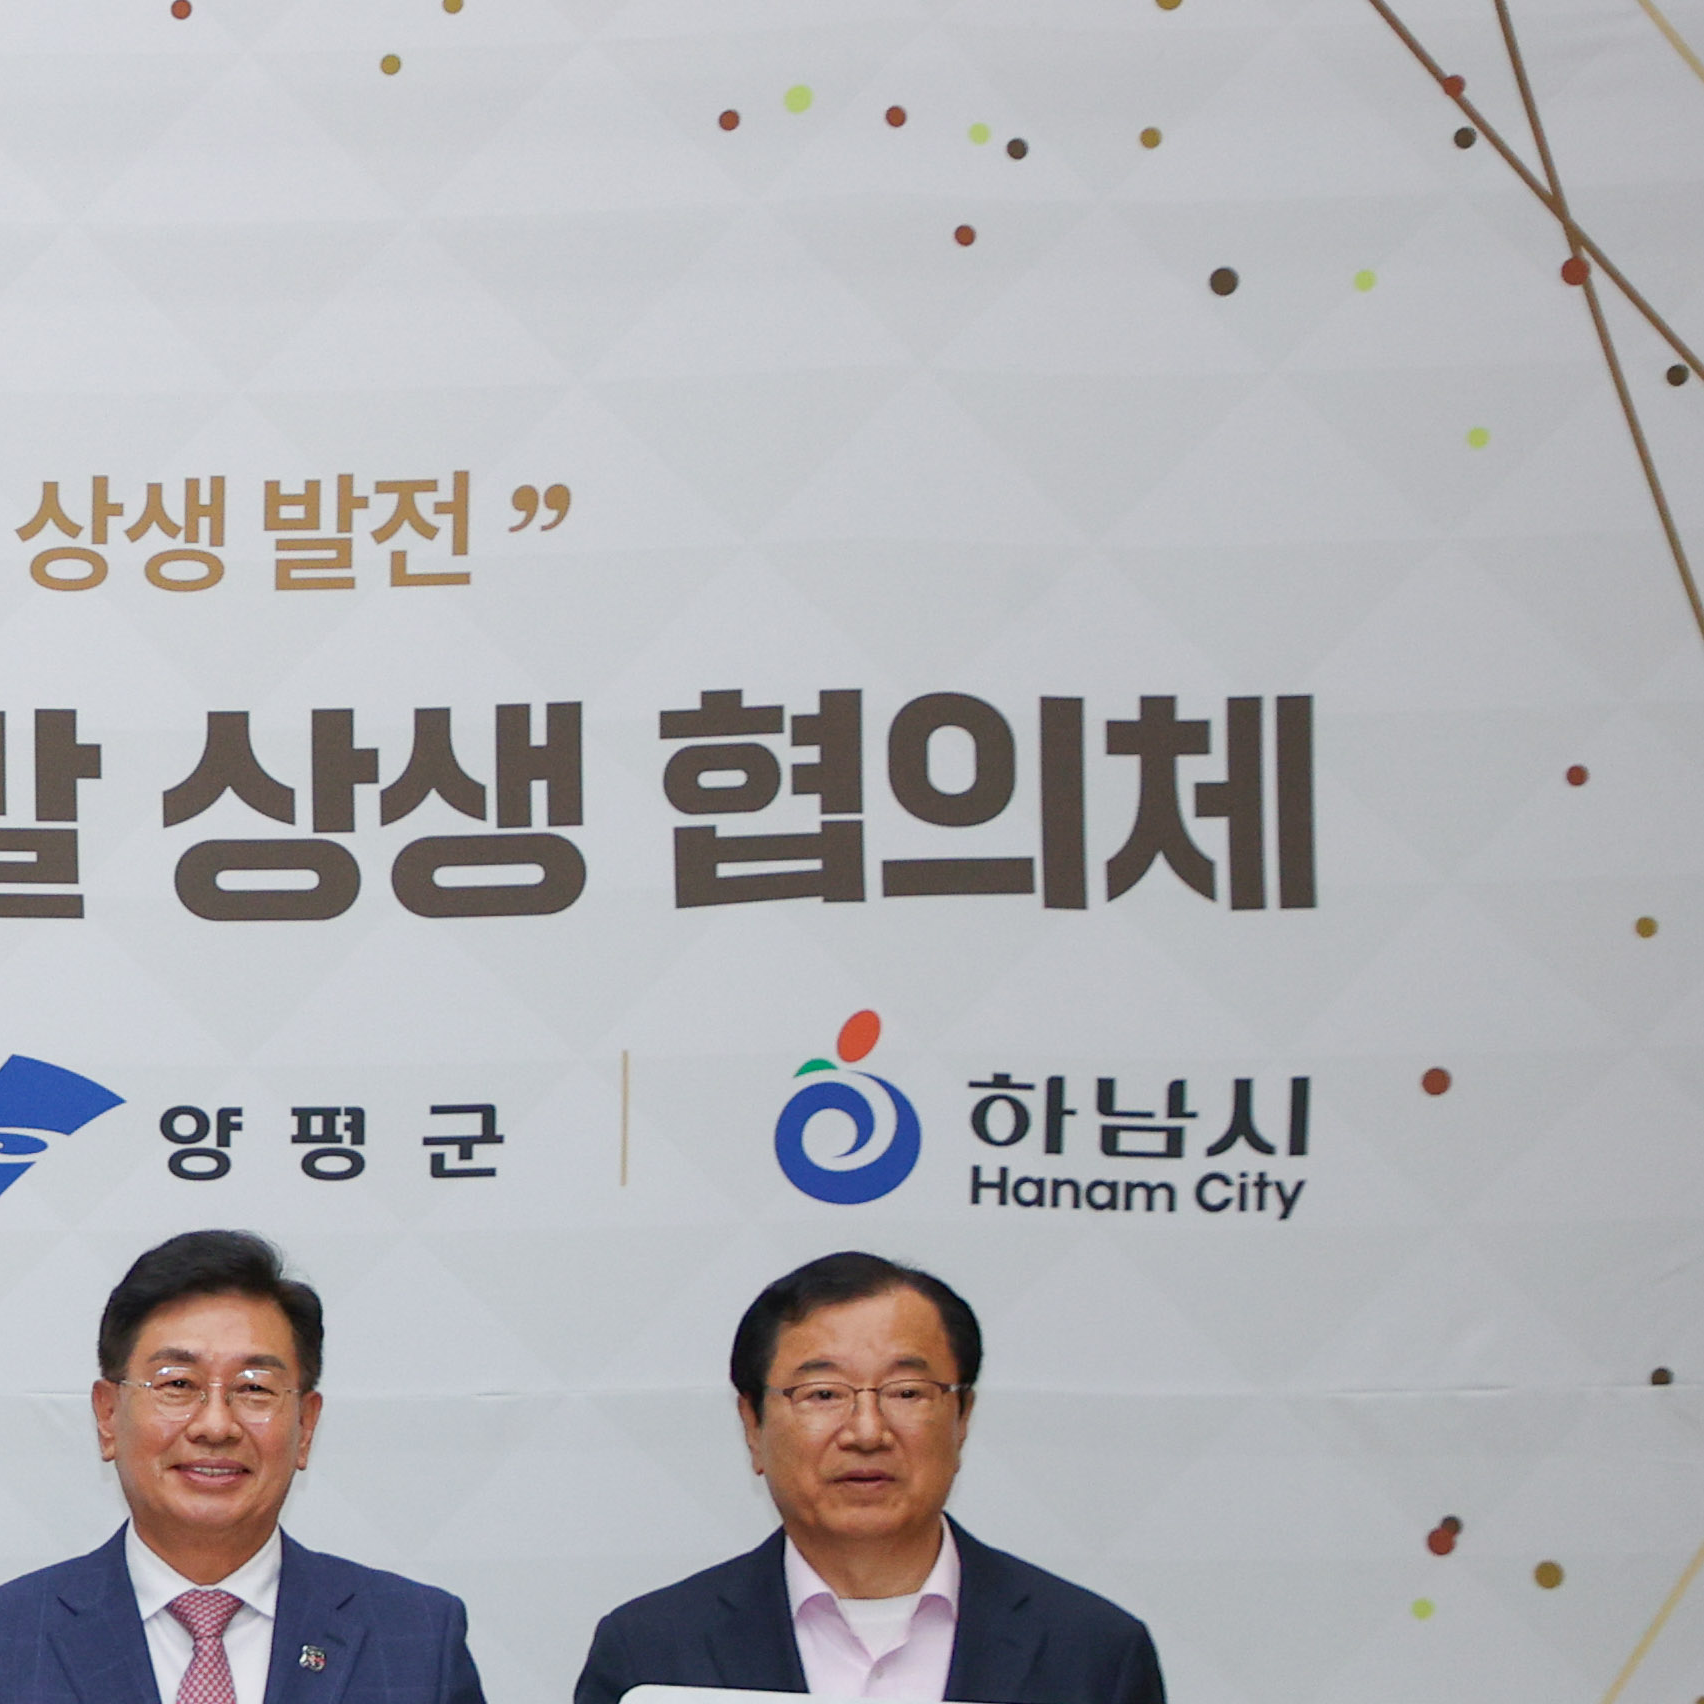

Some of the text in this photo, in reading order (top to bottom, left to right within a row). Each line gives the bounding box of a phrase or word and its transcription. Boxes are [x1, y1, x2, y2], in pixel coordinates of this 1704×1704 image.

[16, 476, 225, 592] 상생
[264, 471, 470, 590] 발전
[163, 701, 587, 921] 상생
[660, 689, 1317, 911] 협의체
[160, 1104, 504, 1181] 양평군
[968, 1073, 1310, 1159] 하남시
[971, 1165, 1305, 1220] Hanam City
